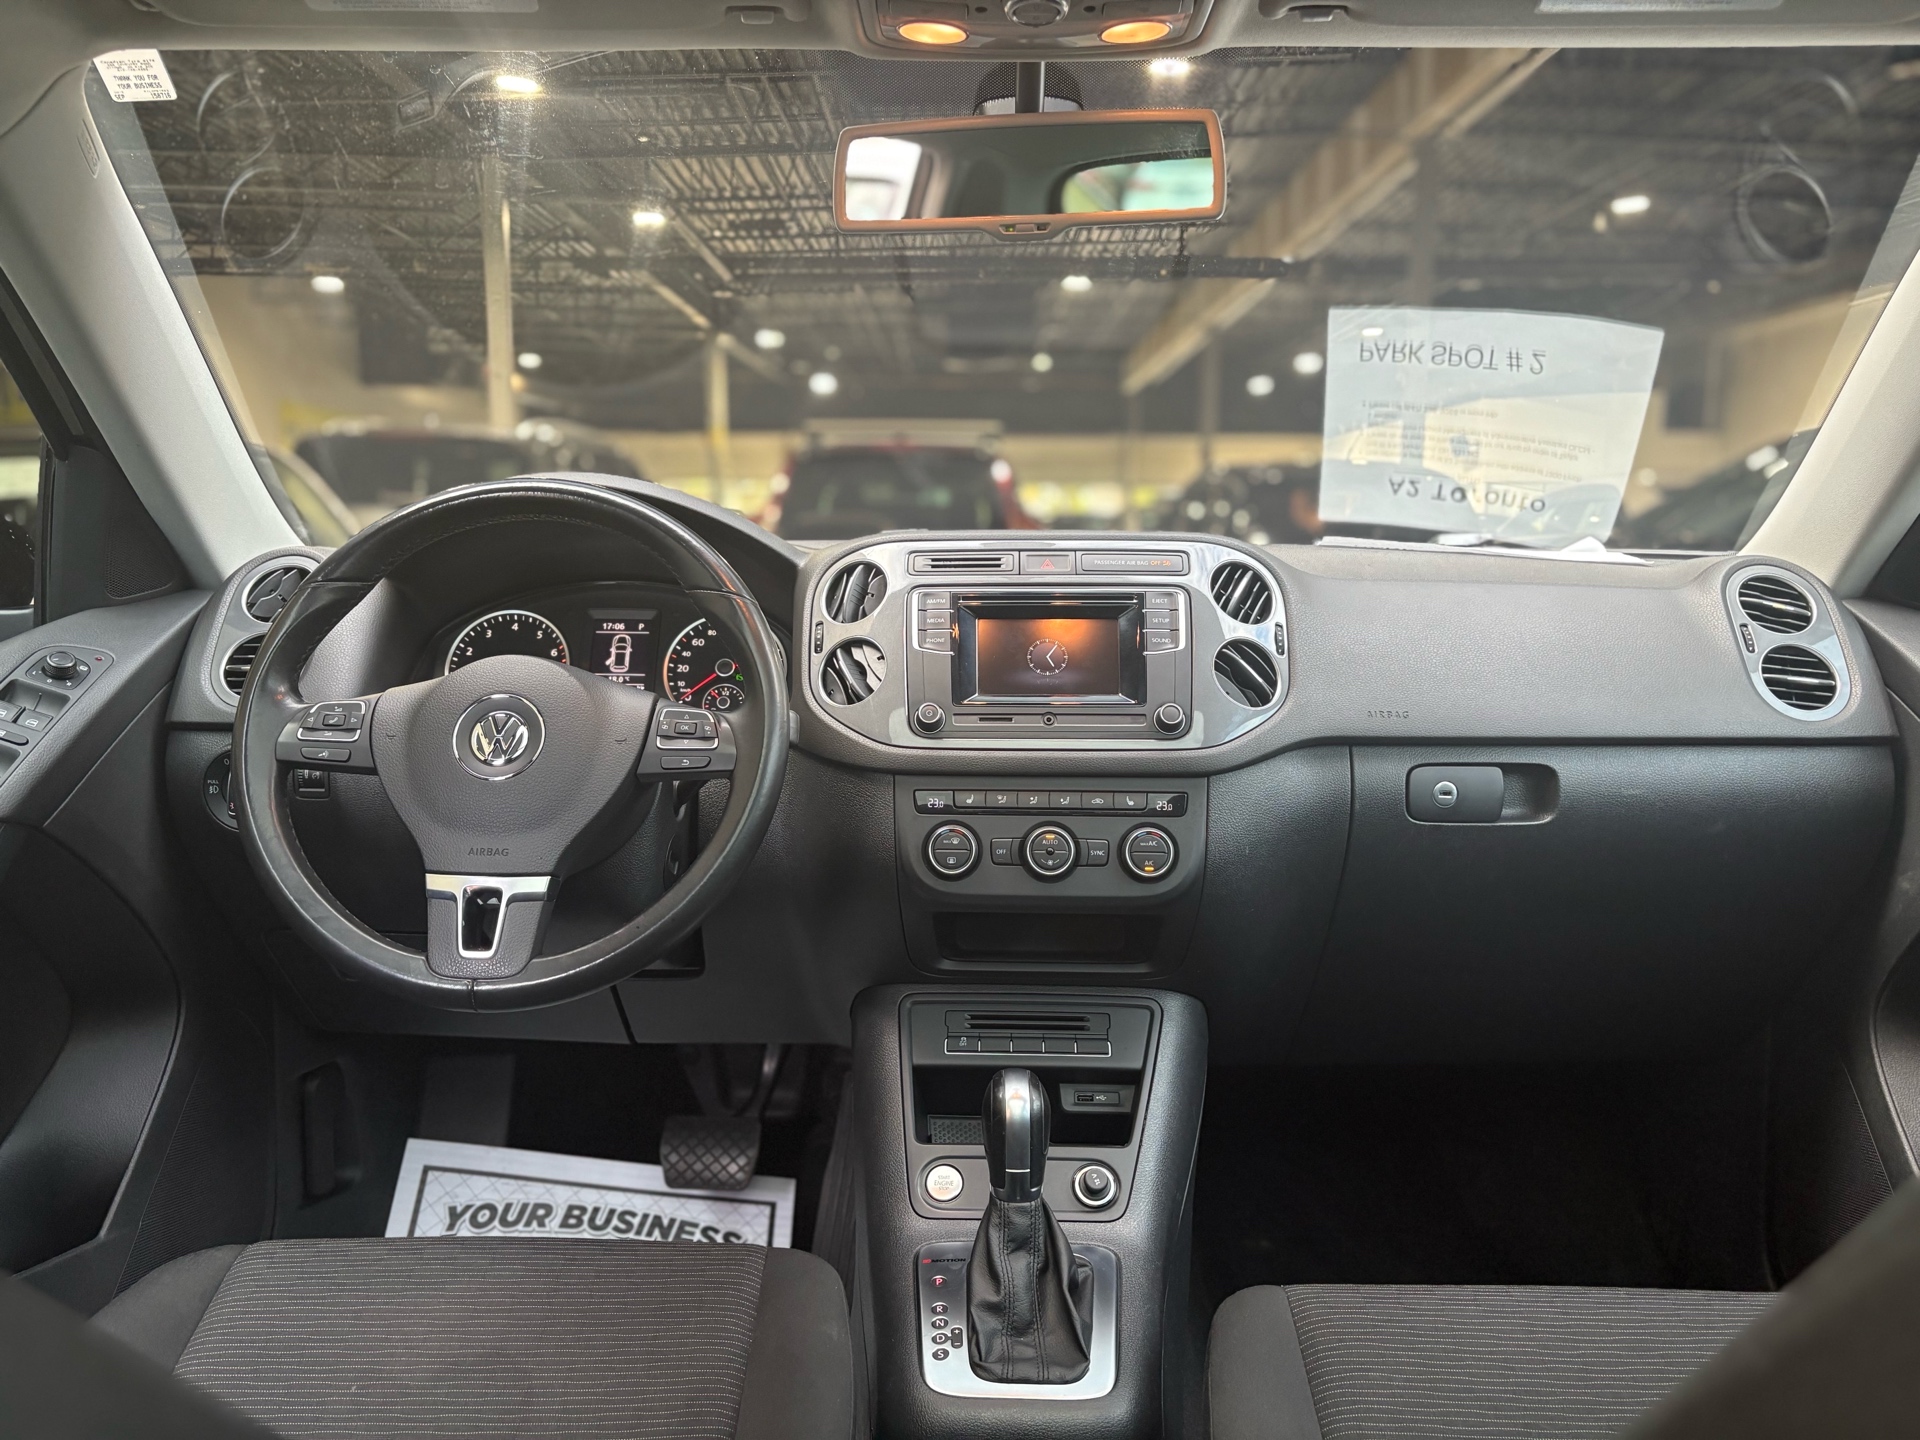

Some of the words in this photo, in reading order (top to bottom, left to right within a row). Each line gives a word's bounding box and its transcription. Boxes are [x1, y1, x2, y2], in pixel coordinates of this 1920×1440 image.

[511, 622, 519, 631] 4
[602, 622, 625, 630] 17:06
[638, 623, 645, 631] P
[485, 629, 492, 638] 3
[536, 630, 543, 639] 5
[691, 638, 705, 646] 60
[465, 647, 473, 656] 2
[550, 648, 558, 657] 6
[676, 664, 690, 672] 20
[1366, 709, 1410, 719] AIRBAG
[467, 846, 510, 858] AIRBAG
[445, 1201, 554, 1232] YOUR
[935, 1278, 943, 1286] P
[936, 1305, 944, 1313] R
[936, 1319, 945, 1327] N
[936, 1334, 945, 1343] D
[937, 1350, 944, 1359] S
